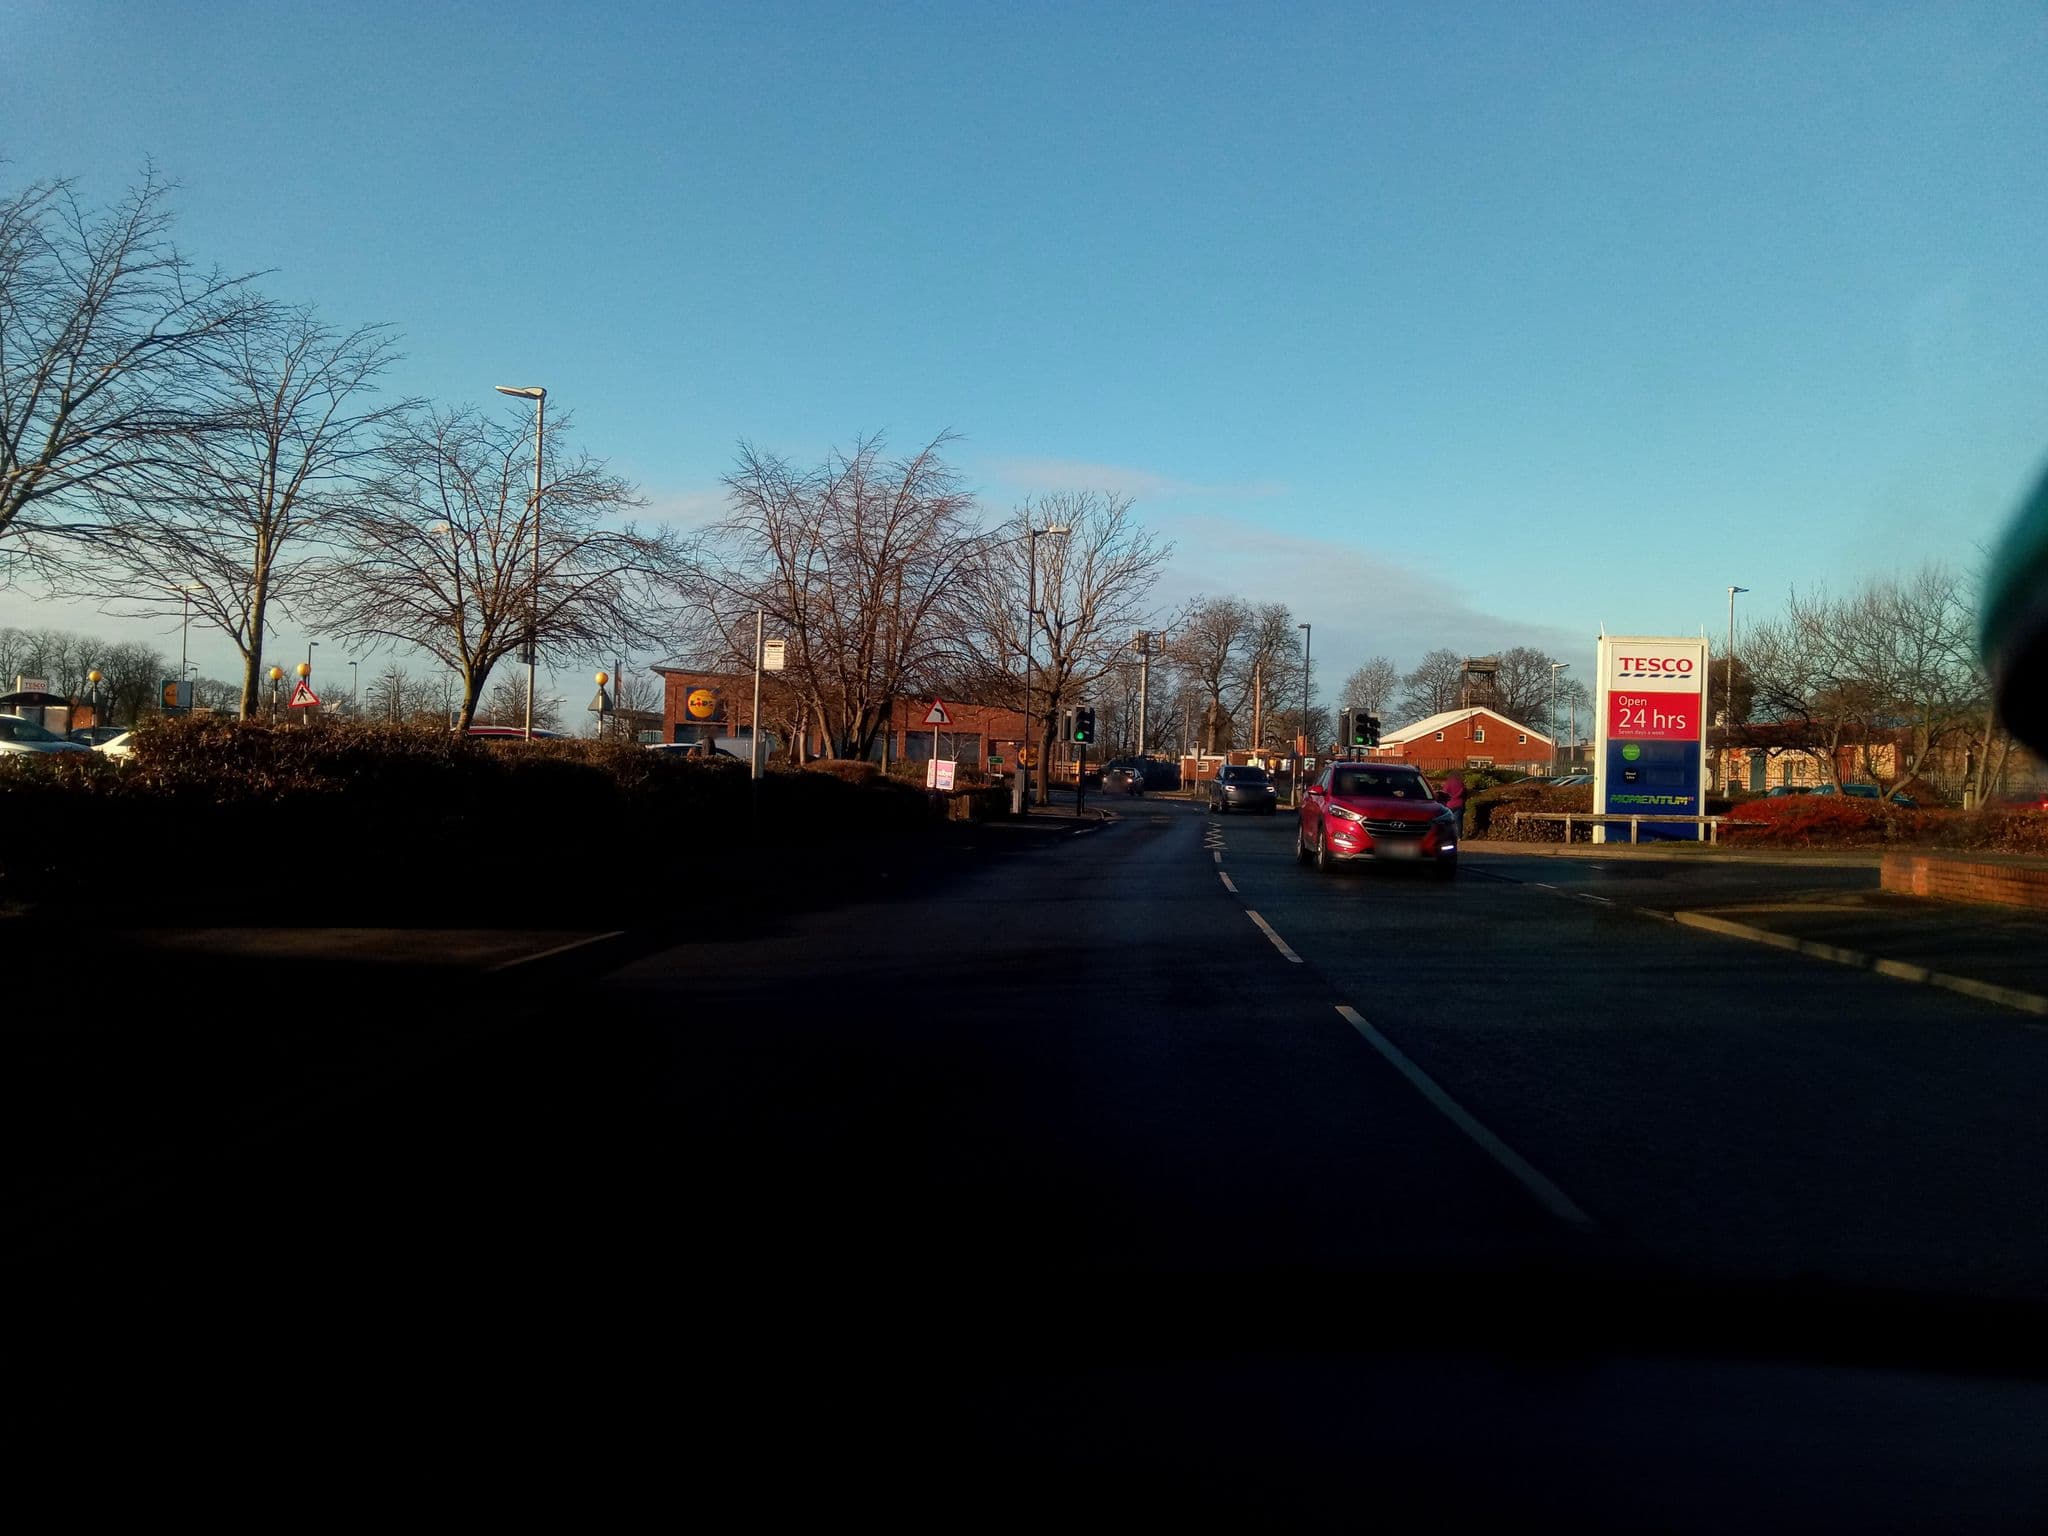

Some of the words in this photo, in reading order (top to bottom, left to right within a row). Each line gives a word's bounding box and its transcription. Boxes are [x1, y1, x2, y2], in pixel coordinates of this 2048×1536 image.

[1618, 657, 1694, 673] TESCO
[1618, 695, 1648, 708] Open
[1618, 708, 1647, 729] 24
[1652, 708, 1687, 730] hrs
[1610, 794, 1689, 806] MOMENTUM
